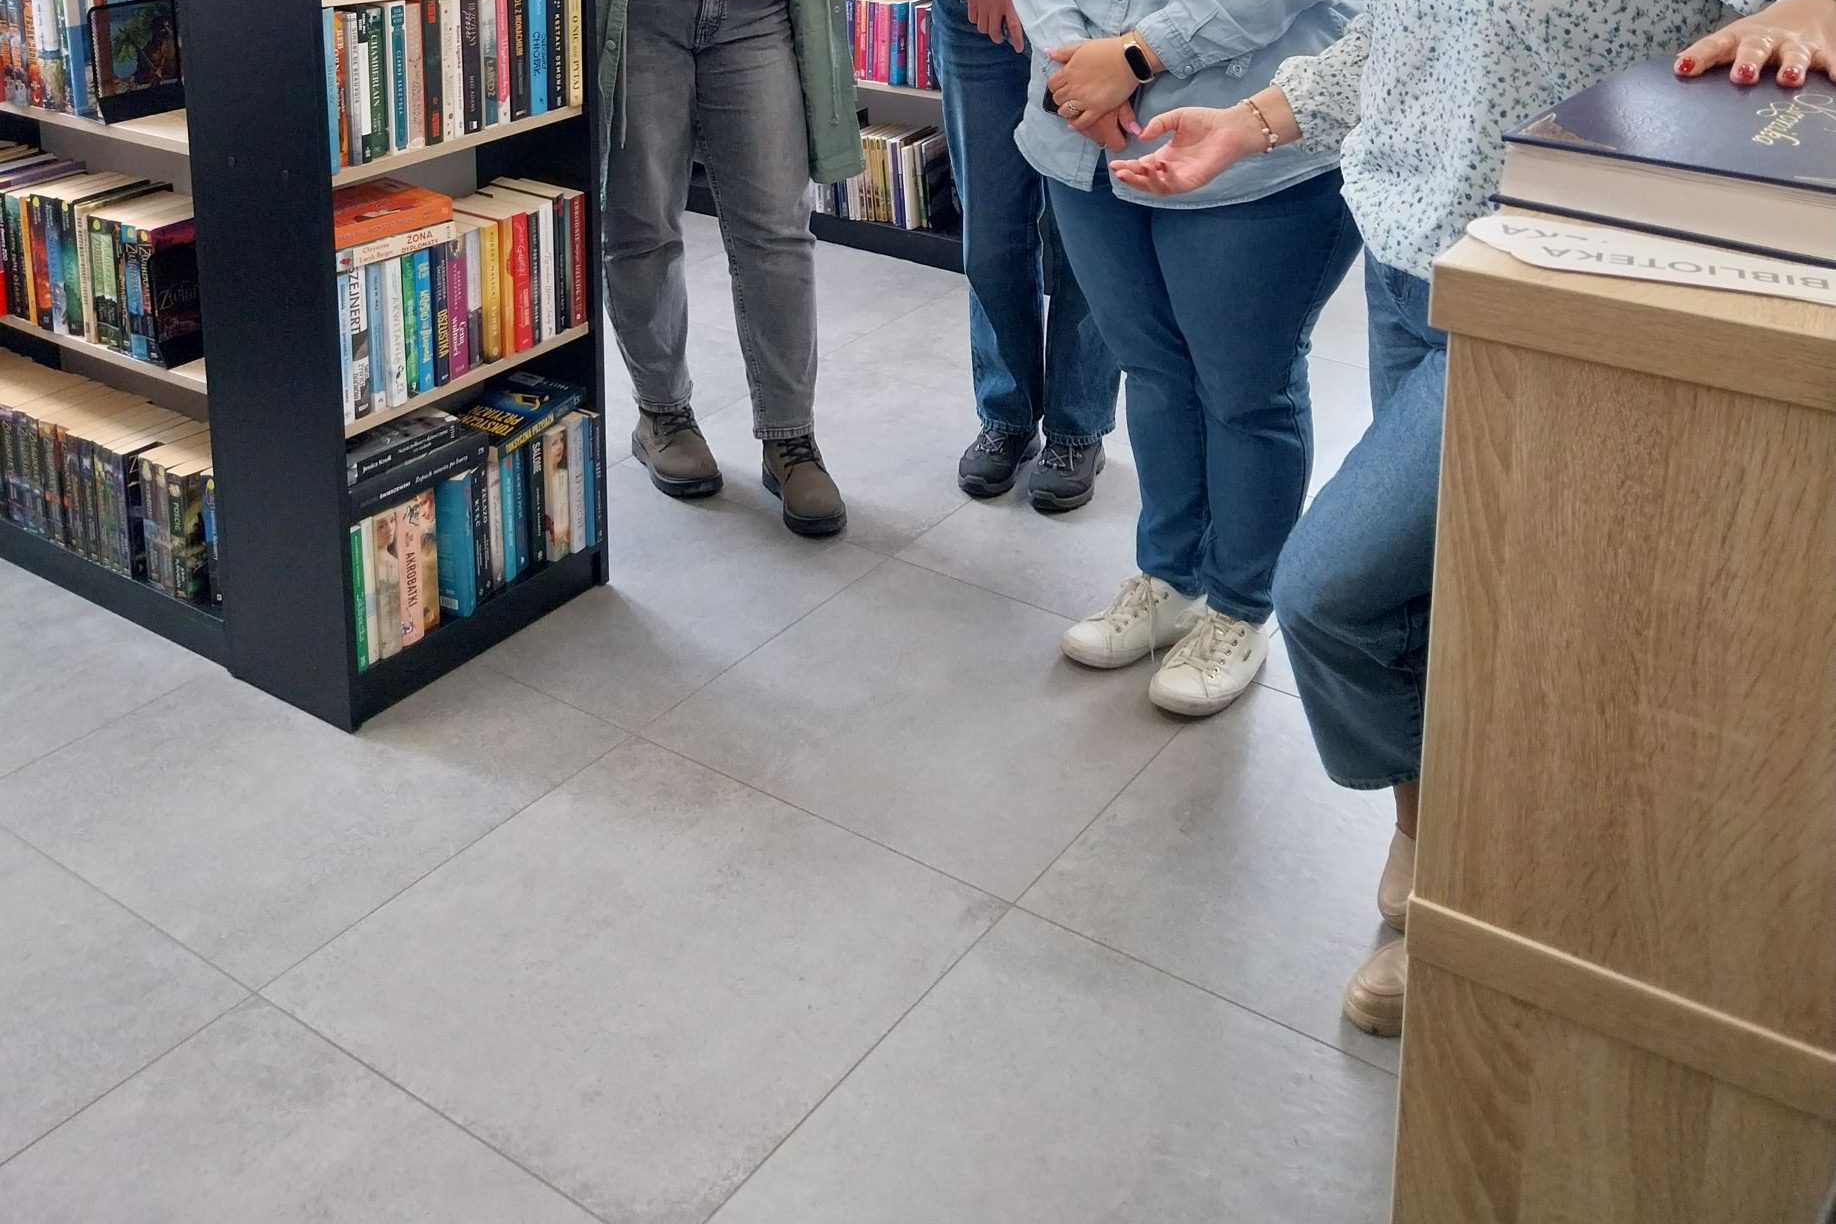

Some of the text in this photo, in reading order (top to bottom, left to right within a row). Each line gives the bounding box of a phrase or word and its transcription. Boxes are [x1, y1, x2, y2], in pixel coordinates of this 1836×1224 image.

[515, 15, 524, 57] MONACHIUM
[571, 24, 579, 44] NIC
[353, 55, 358, 65] DE
[371, 34, 381, 106] CHAMBERLAIN
[572, 60, 580, 90] PYTAJ
[574, 264, 582, 302] DZIADKA
[1542, 244, 1831, 291] BIBLIOTEKA
[348, 267, 362, 333] SZEJNERT
[437, 310, 449, 358] OSZUSTKA
[452, 316, 460, 356] wolności
[458, 321, 466, 345] Cena
[532, 442, 541, 474] SALOME
[405, 552, 418, 608] AKROBATKI
